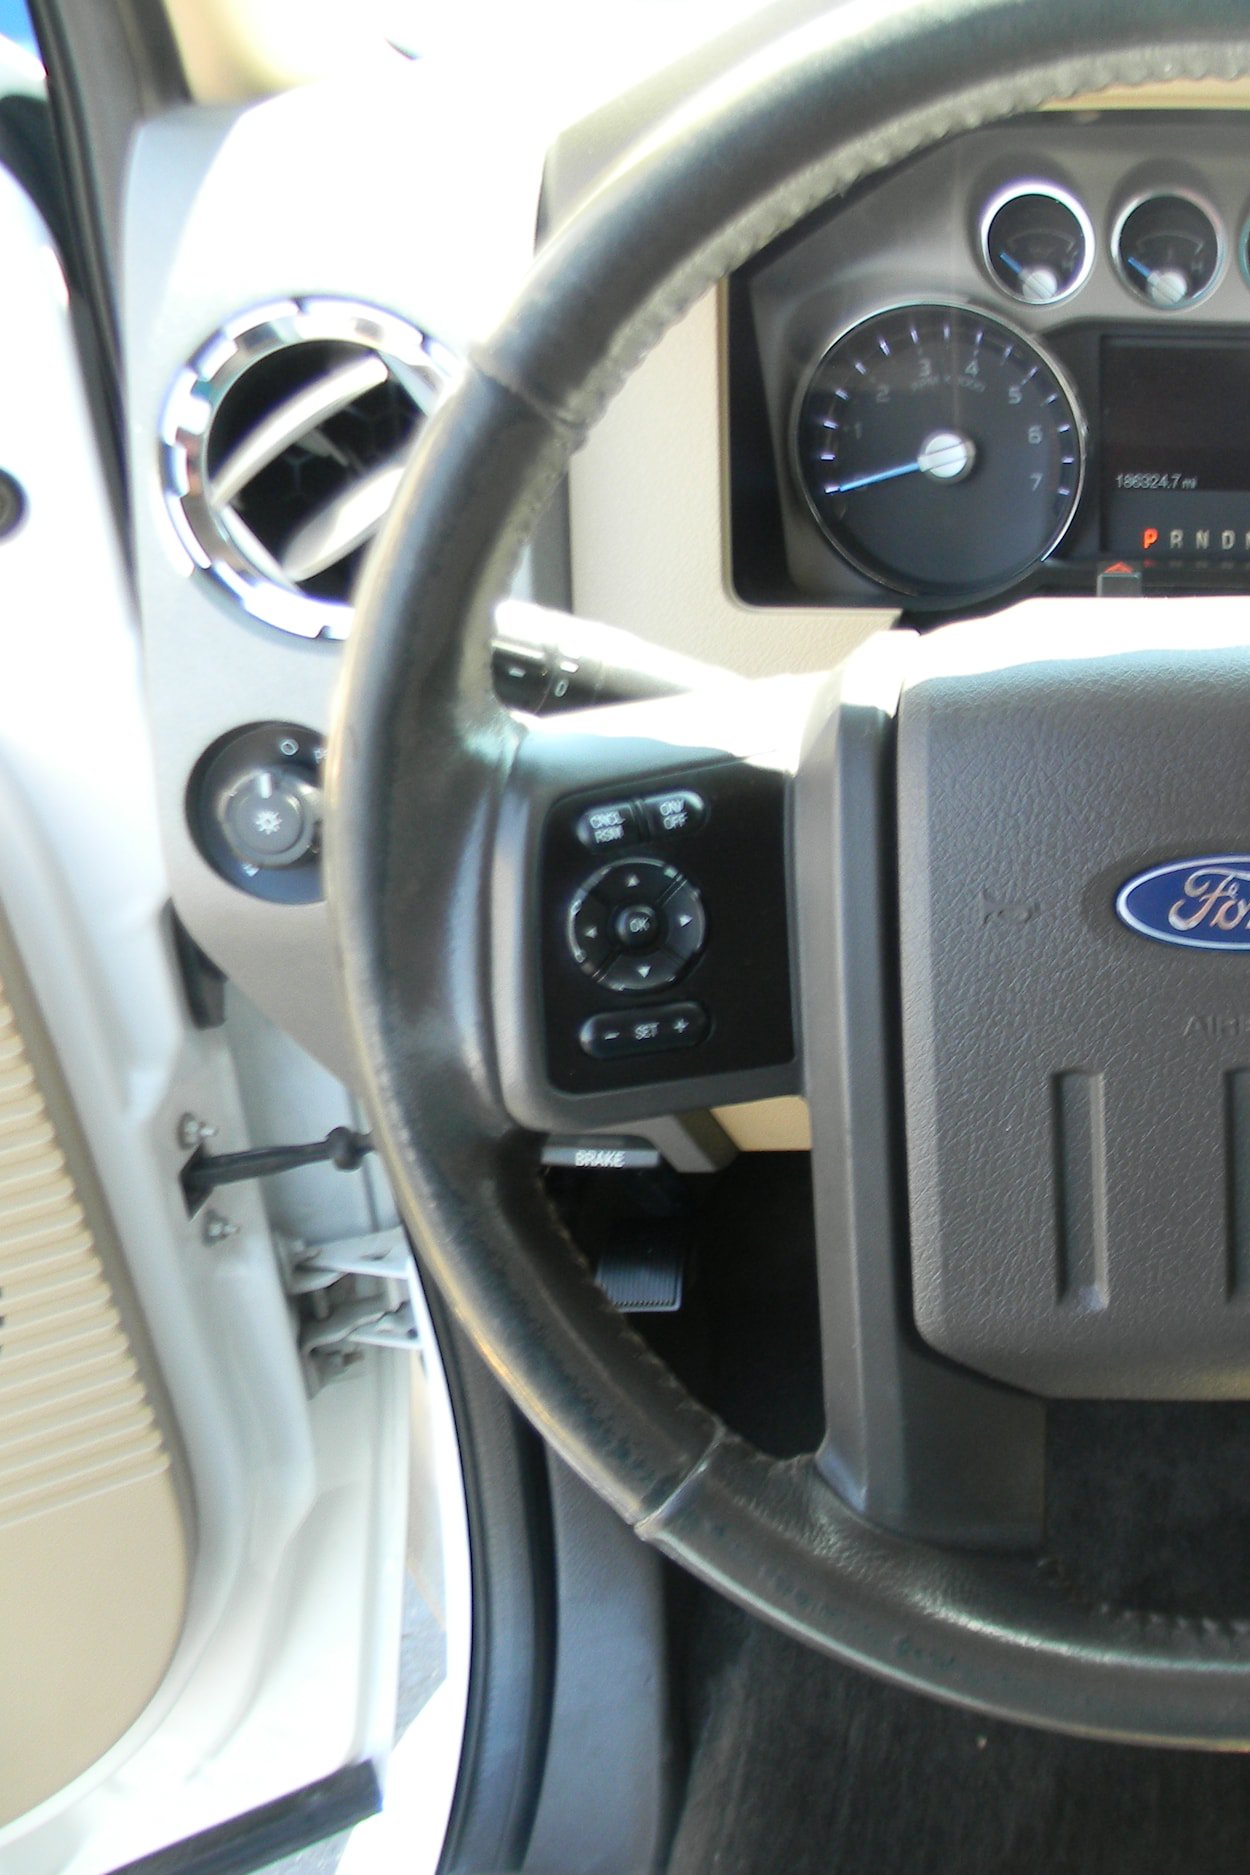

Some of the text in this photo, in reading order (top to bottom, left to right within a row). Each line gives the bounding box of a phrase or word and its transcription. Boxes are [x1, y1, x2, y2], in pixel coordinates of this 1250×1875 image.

[918, 358, 931, 377] 3
[965, 360, 979, 377] 4
[875, 387, 890, 404] 2
[1008, 385, 1022, 404] 5
[1028, 424, 1042, 444] 6
[1029, 472, 1044, 492] 7
[1143, 528, 1159, 549] P
[1169, 529, 1184, 549] R
[1195, 529, 1210, 550] N
[1221, 530, 1236, 550] D
[664, 812, 688, 829] OFF
[629, 917, 650, 933] OK
[634, 1022, 660, 1040] SET
[574, 1149, 626, 1168] BRAKE
